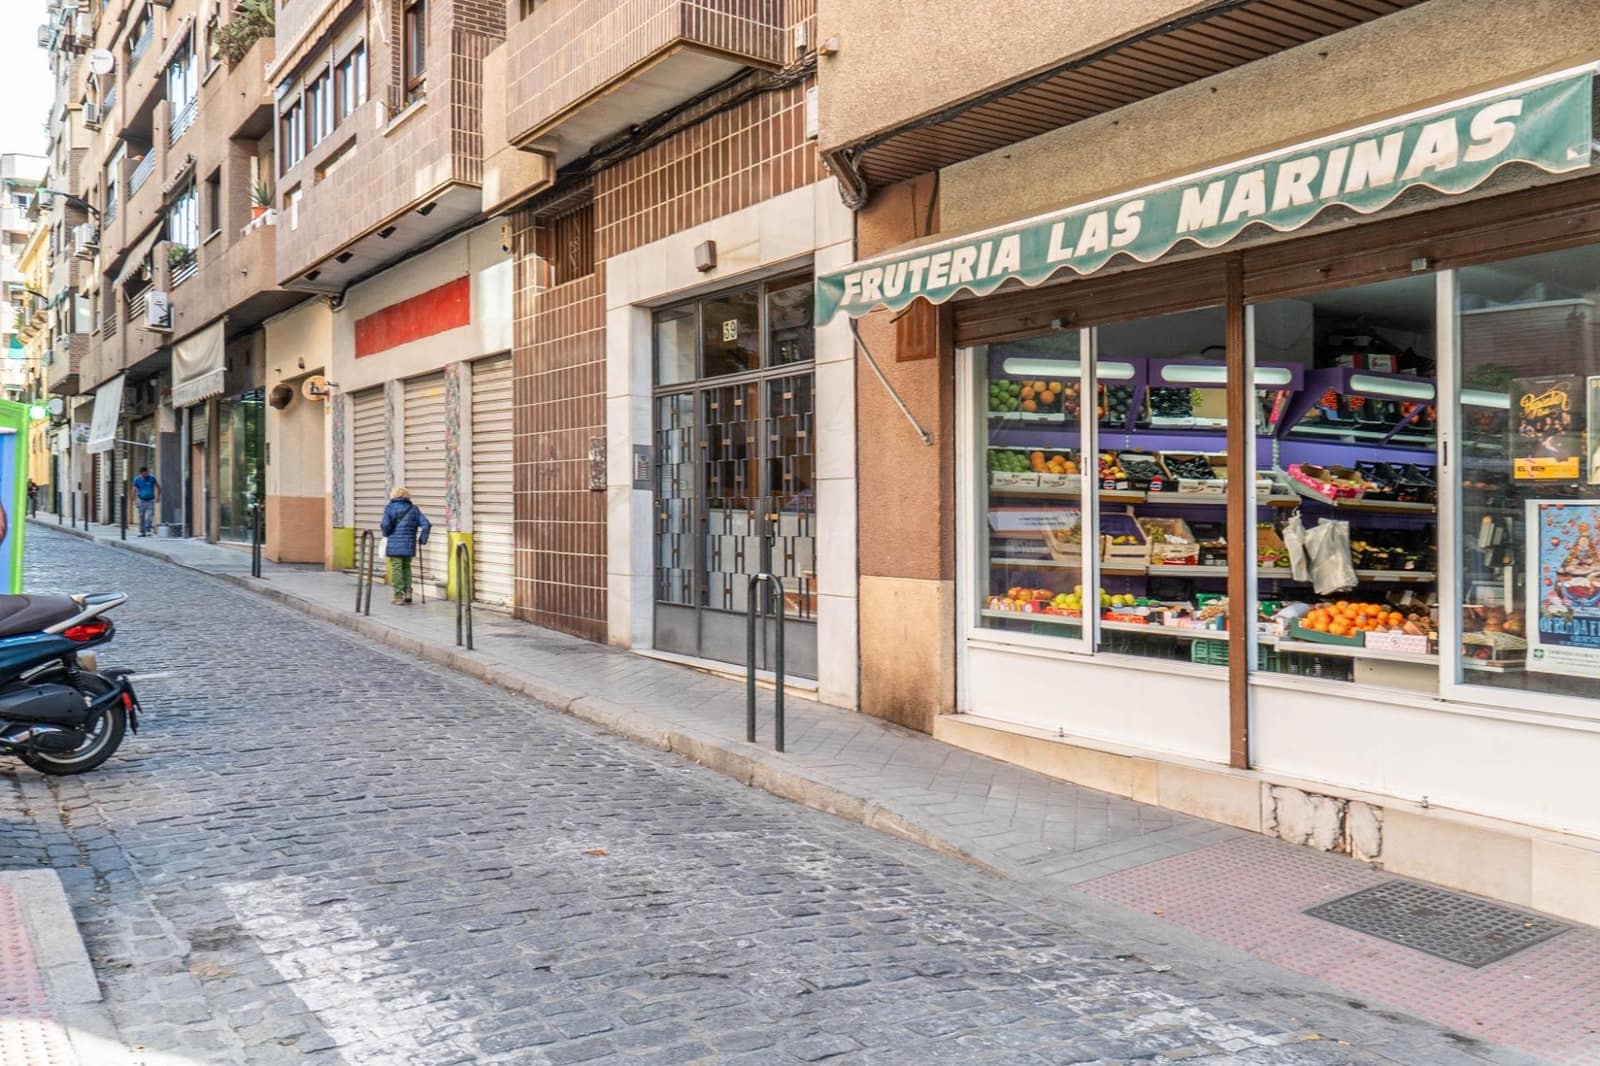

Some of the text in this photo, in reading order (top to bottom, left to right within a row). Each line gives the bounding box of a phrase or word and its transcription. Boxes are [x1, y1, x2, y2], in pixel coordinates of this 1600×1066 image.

[840, 99, 1523, 306] FRUTERIA LAS MARINAS
